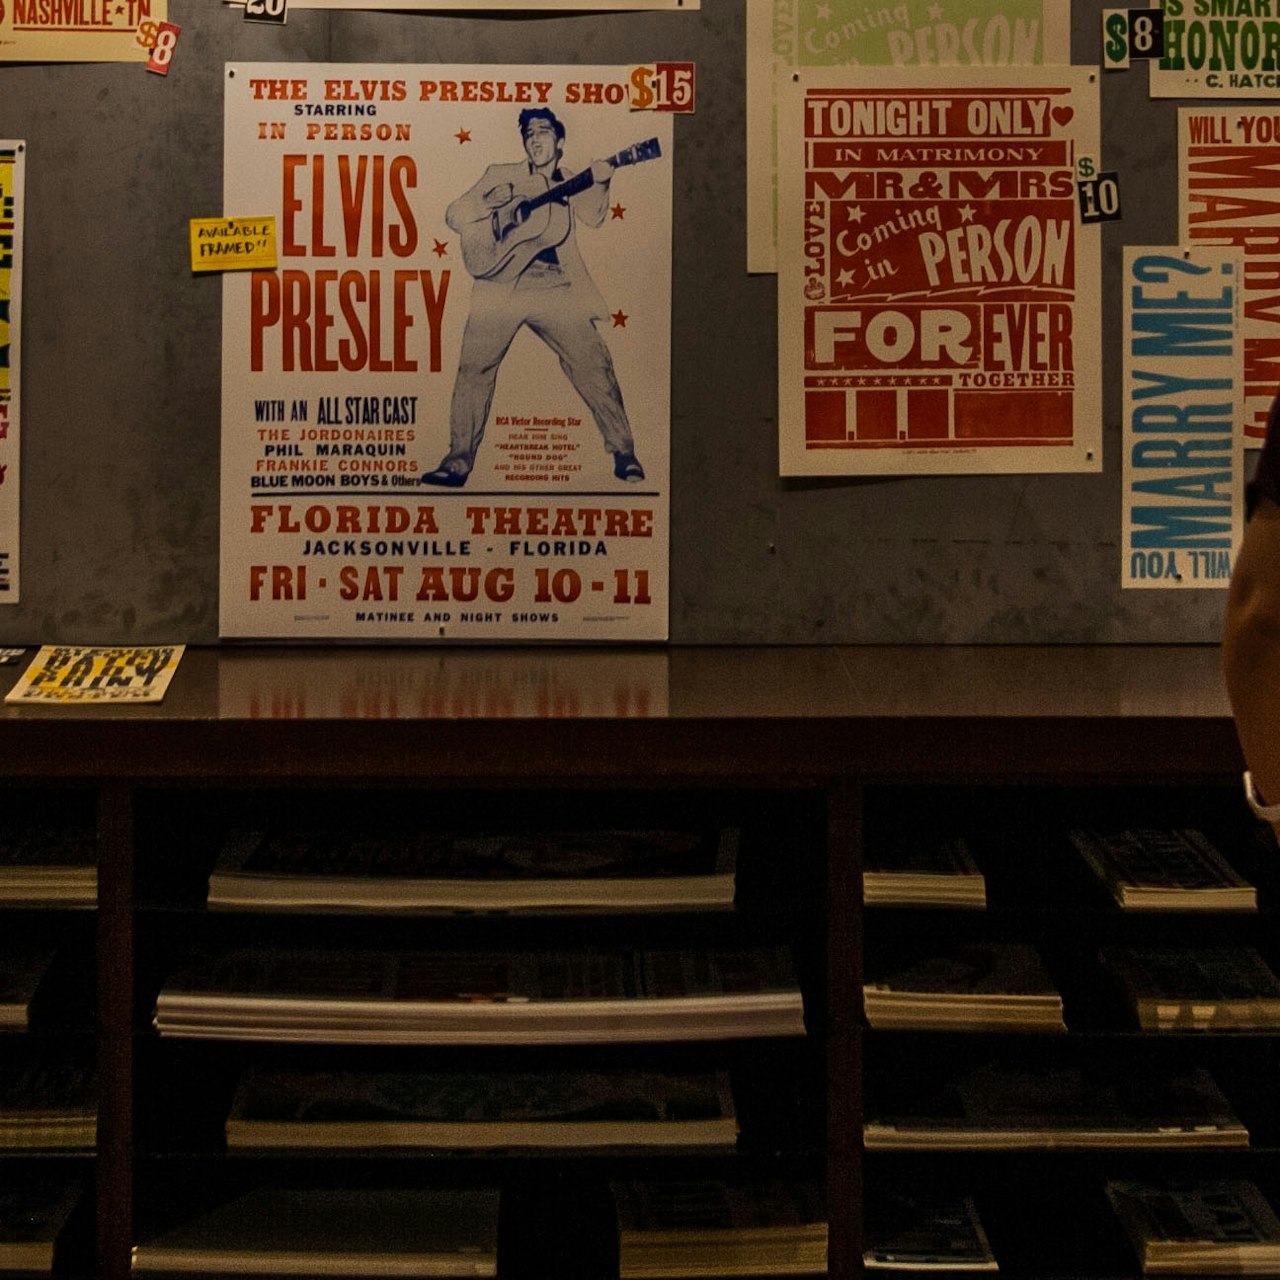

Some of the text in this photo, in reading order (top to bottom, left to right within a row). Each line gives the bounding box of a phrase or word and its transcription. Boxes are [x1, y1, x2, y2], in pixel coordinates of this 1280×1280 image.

[808, 98, 1050, 136] TONIGHT ONLY
[834, 146, 1044, 162] IN MATRIMONY
[283, 154, 418, 257] ELVIS
[198, 225, 271, 238] AVAILABLE
[250, 270, 451, 373] PRESLEY
[257, 429, 416, 442] THE JORDONAIRES
[250, 505, 653, 537] FLORIDA THEATRE
[303, 541, 608, 556] JACKSONVILLE FLORIDA
[356, 613, 559, 623] MATINEE AND NIGHT SHOWS
